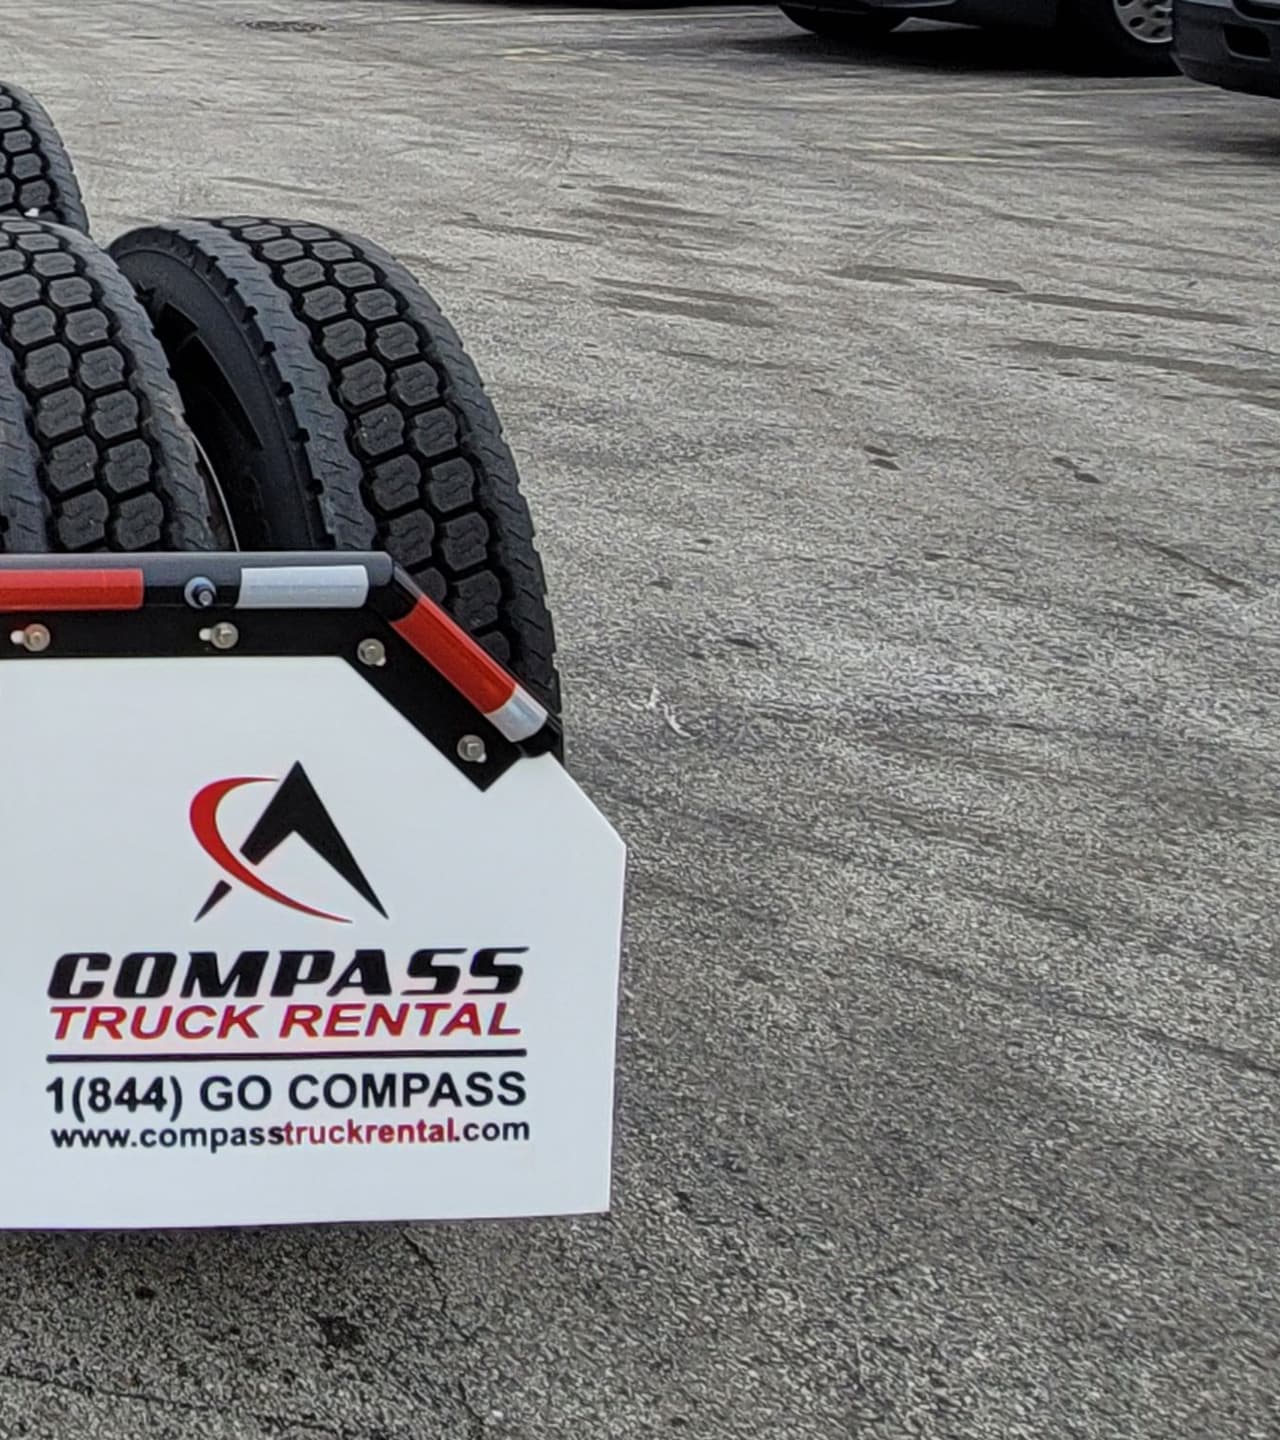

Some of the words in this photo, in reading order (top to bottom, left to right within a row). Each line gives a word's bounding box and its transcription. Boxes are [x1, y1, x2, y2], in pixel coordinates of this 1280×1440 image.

[48, 947, 528, 999] COMPASS
[50, 1005, 264, 1040] TRUCK
[279, 1002, 520, 1039] RENTAL
[46, 1075, 182, 1122] 1(844)
[200, 1075, 272, 1112] GO
[288, 1071, 526, 1110] COMPASS
[50, 1118, 530, 1154] www.compasstruckrental.com
